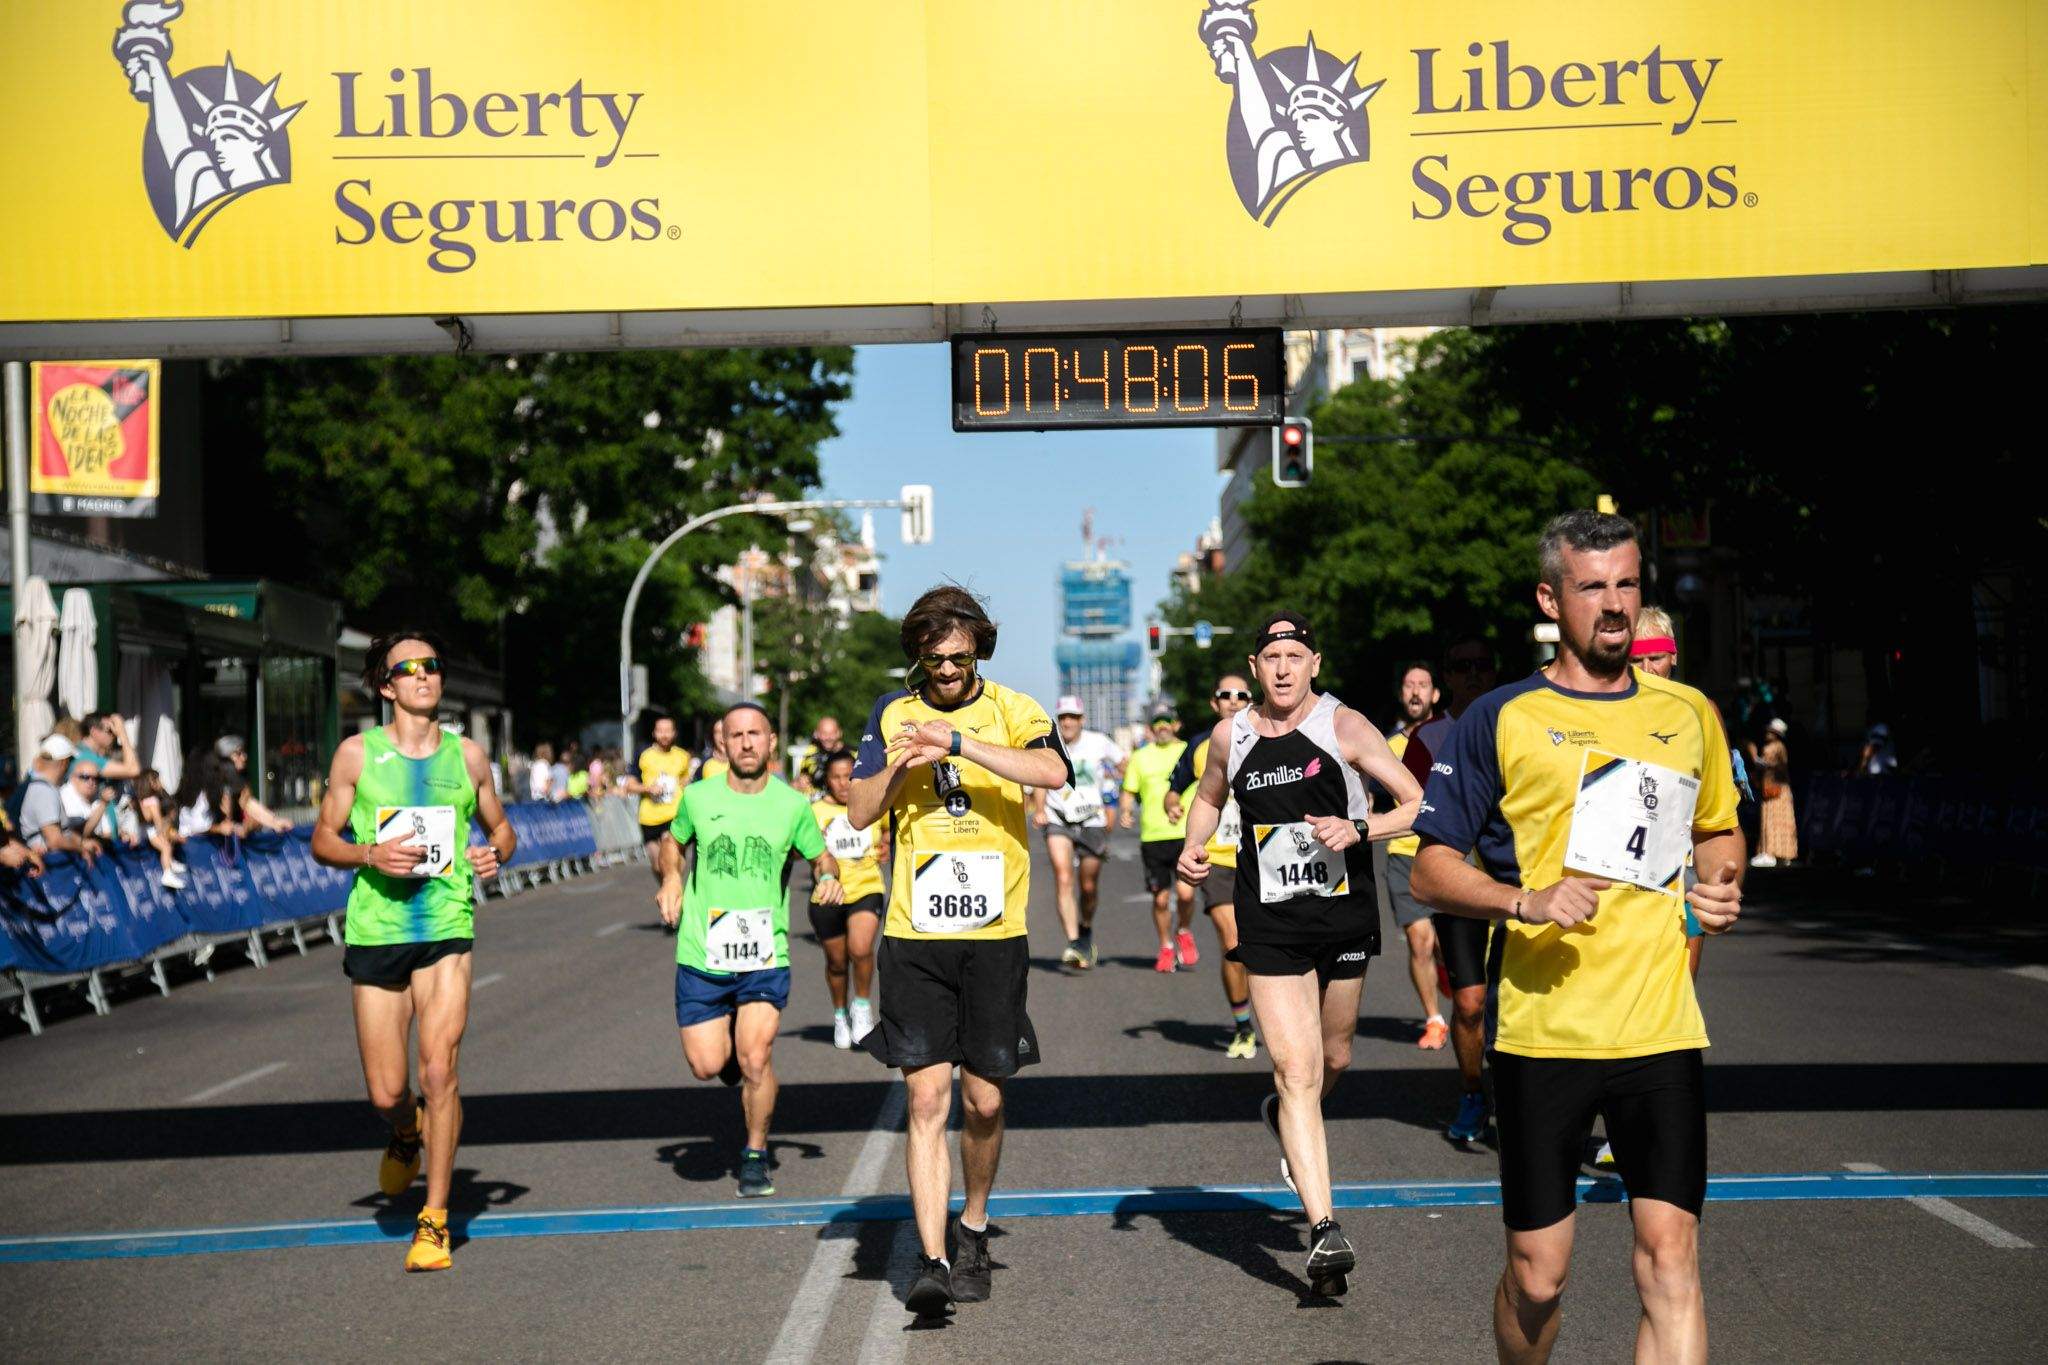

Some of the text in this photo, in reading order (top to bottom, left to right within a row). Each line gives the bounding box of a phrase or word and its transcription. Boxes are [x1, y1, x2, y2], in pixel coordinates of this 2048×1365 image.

[1410, 40, 1723, 135] Liberty
[331, 67, 644, 168] Liberty
[71, 389, 89, 401] LA
[53, 396, 109, 423] NOCHE
[950, 797, 966, 811] 13
[953, 826, 979, 834] Liberty
[1625, 825, 1648, 861] 4
[1277, 861, 1329, 887] 1448
[928, 894, 988, 919] 3683
[722, 941, 759, 960] 1144
